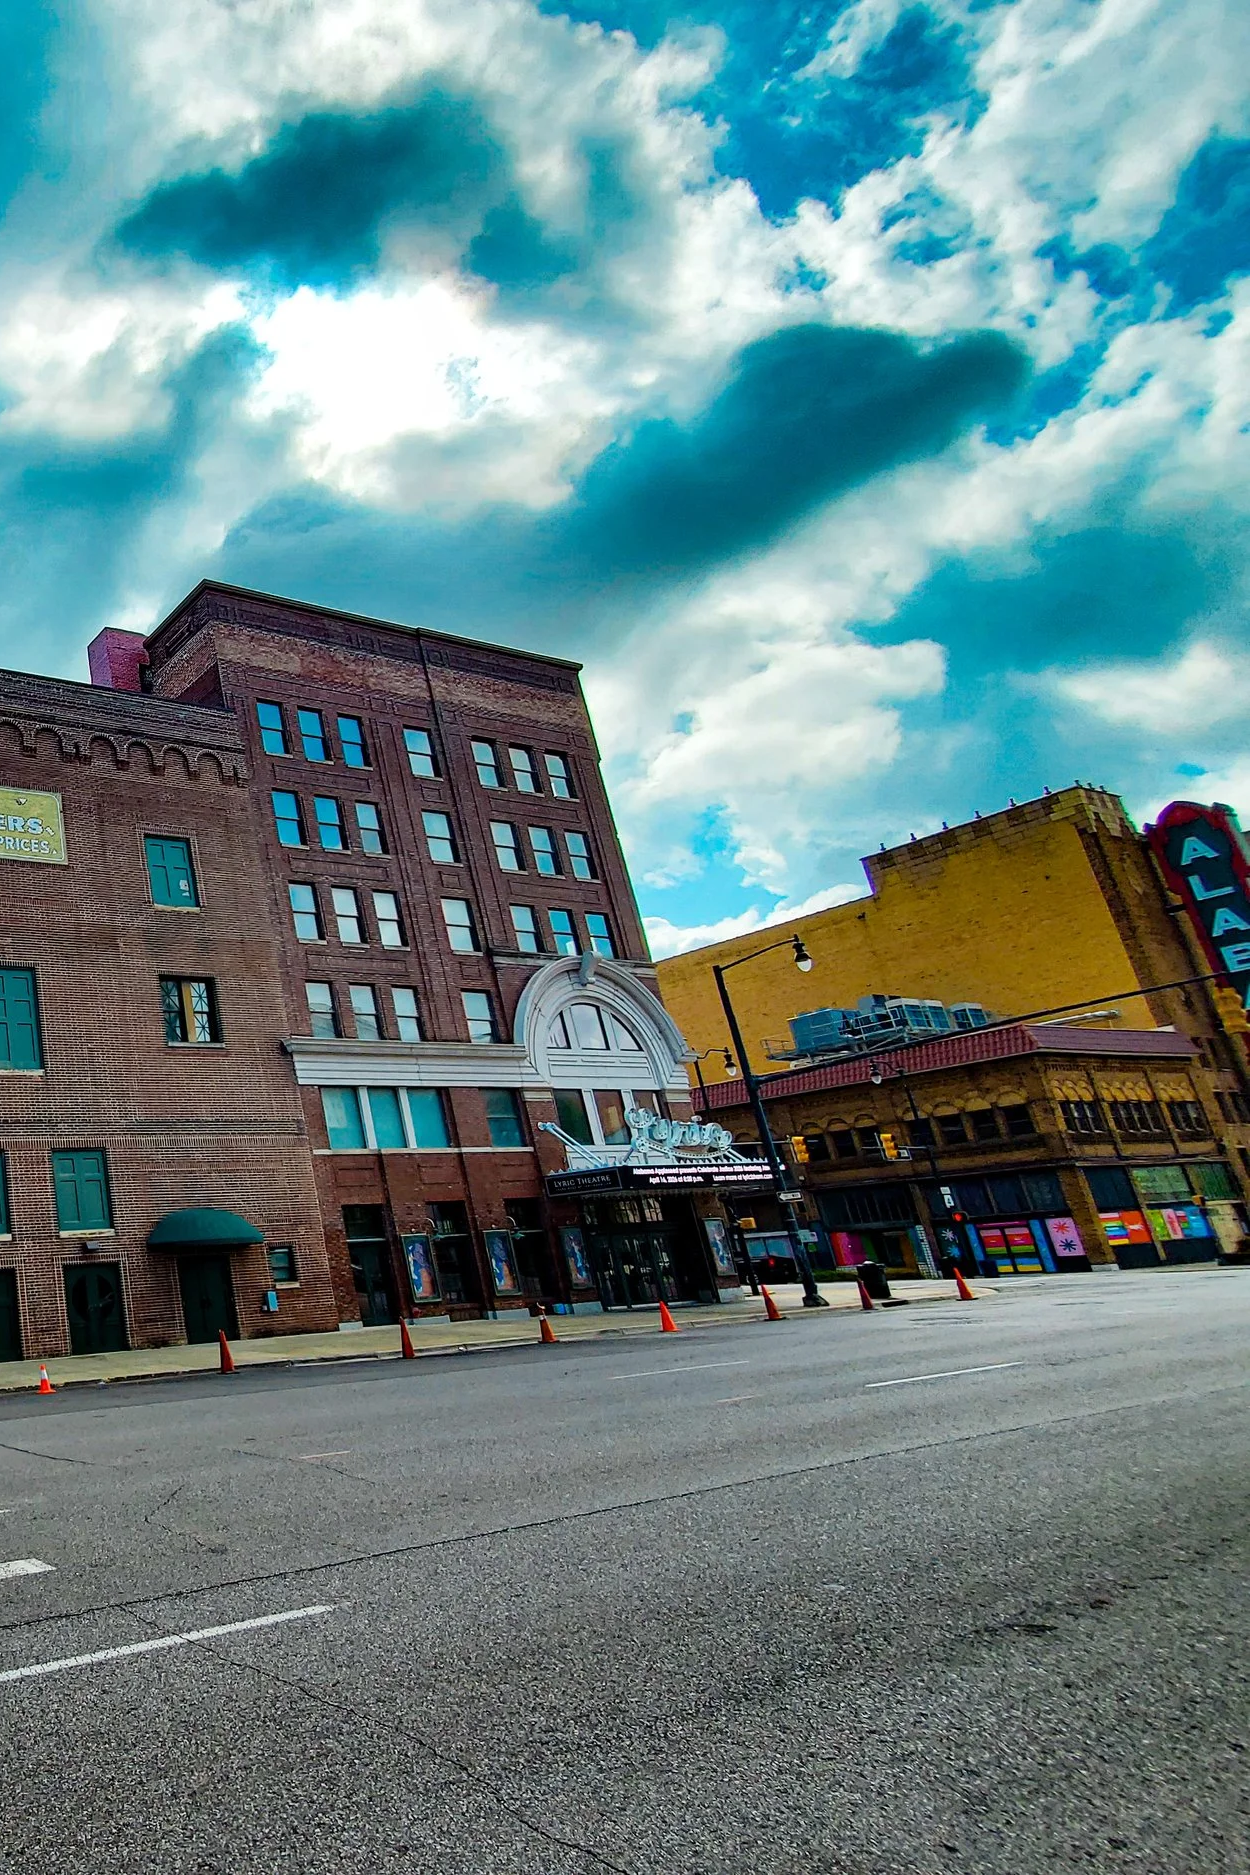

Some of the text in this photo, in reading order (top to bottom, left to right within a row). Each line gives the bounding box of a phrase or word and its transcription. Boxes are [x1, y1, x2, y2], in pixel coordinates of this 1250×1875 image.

[1180, 836, 1250, 1010] ALAB
[554, 1179, 576, 1188] LYRIC
[577, 1174, 611, 1185] THEATRE
